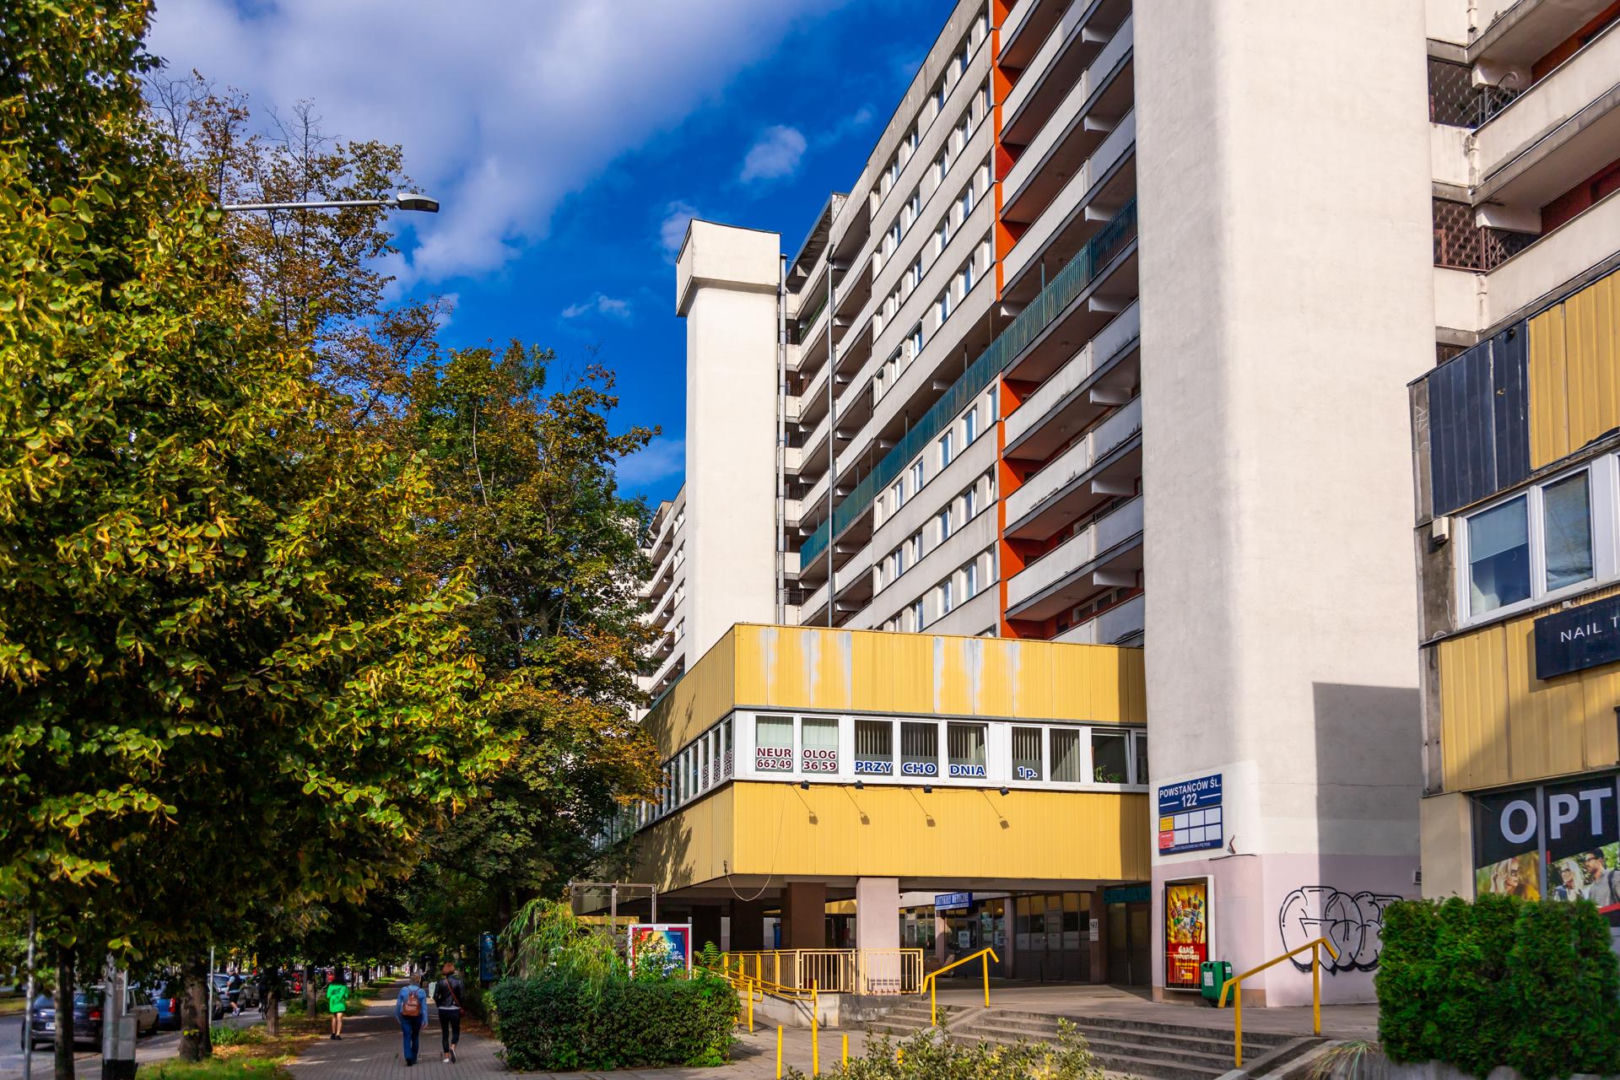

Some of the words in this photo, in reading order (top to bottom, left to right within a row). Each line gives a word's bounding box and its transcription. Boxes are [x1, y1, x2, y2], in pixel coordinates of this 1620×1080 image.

[1560, 622, 1602, 643] NAIL
[757, 747, 792, 758] NEUR
[803, 749, 836, 759] OLOG
[757, 759, 776, 769] 662
[779, 760, 792, 769] 49
[803, 761, 818, 770] 36
[821, 762, 837, 771] 59
[855, 761, 892, 773] PRZY
[903, 763, 936, 775] CHO
[949, 765, 986, 776] DNIA
[1018, 766, 1037, 780] 1p.
[1159, 779, 1208, 799] POWSTAŃCÓW
[1209, 777, 1222, 789] ŚL.
[1182, 793, 1198, 808] 122
[1500, 787, 1612, 844] OPT
